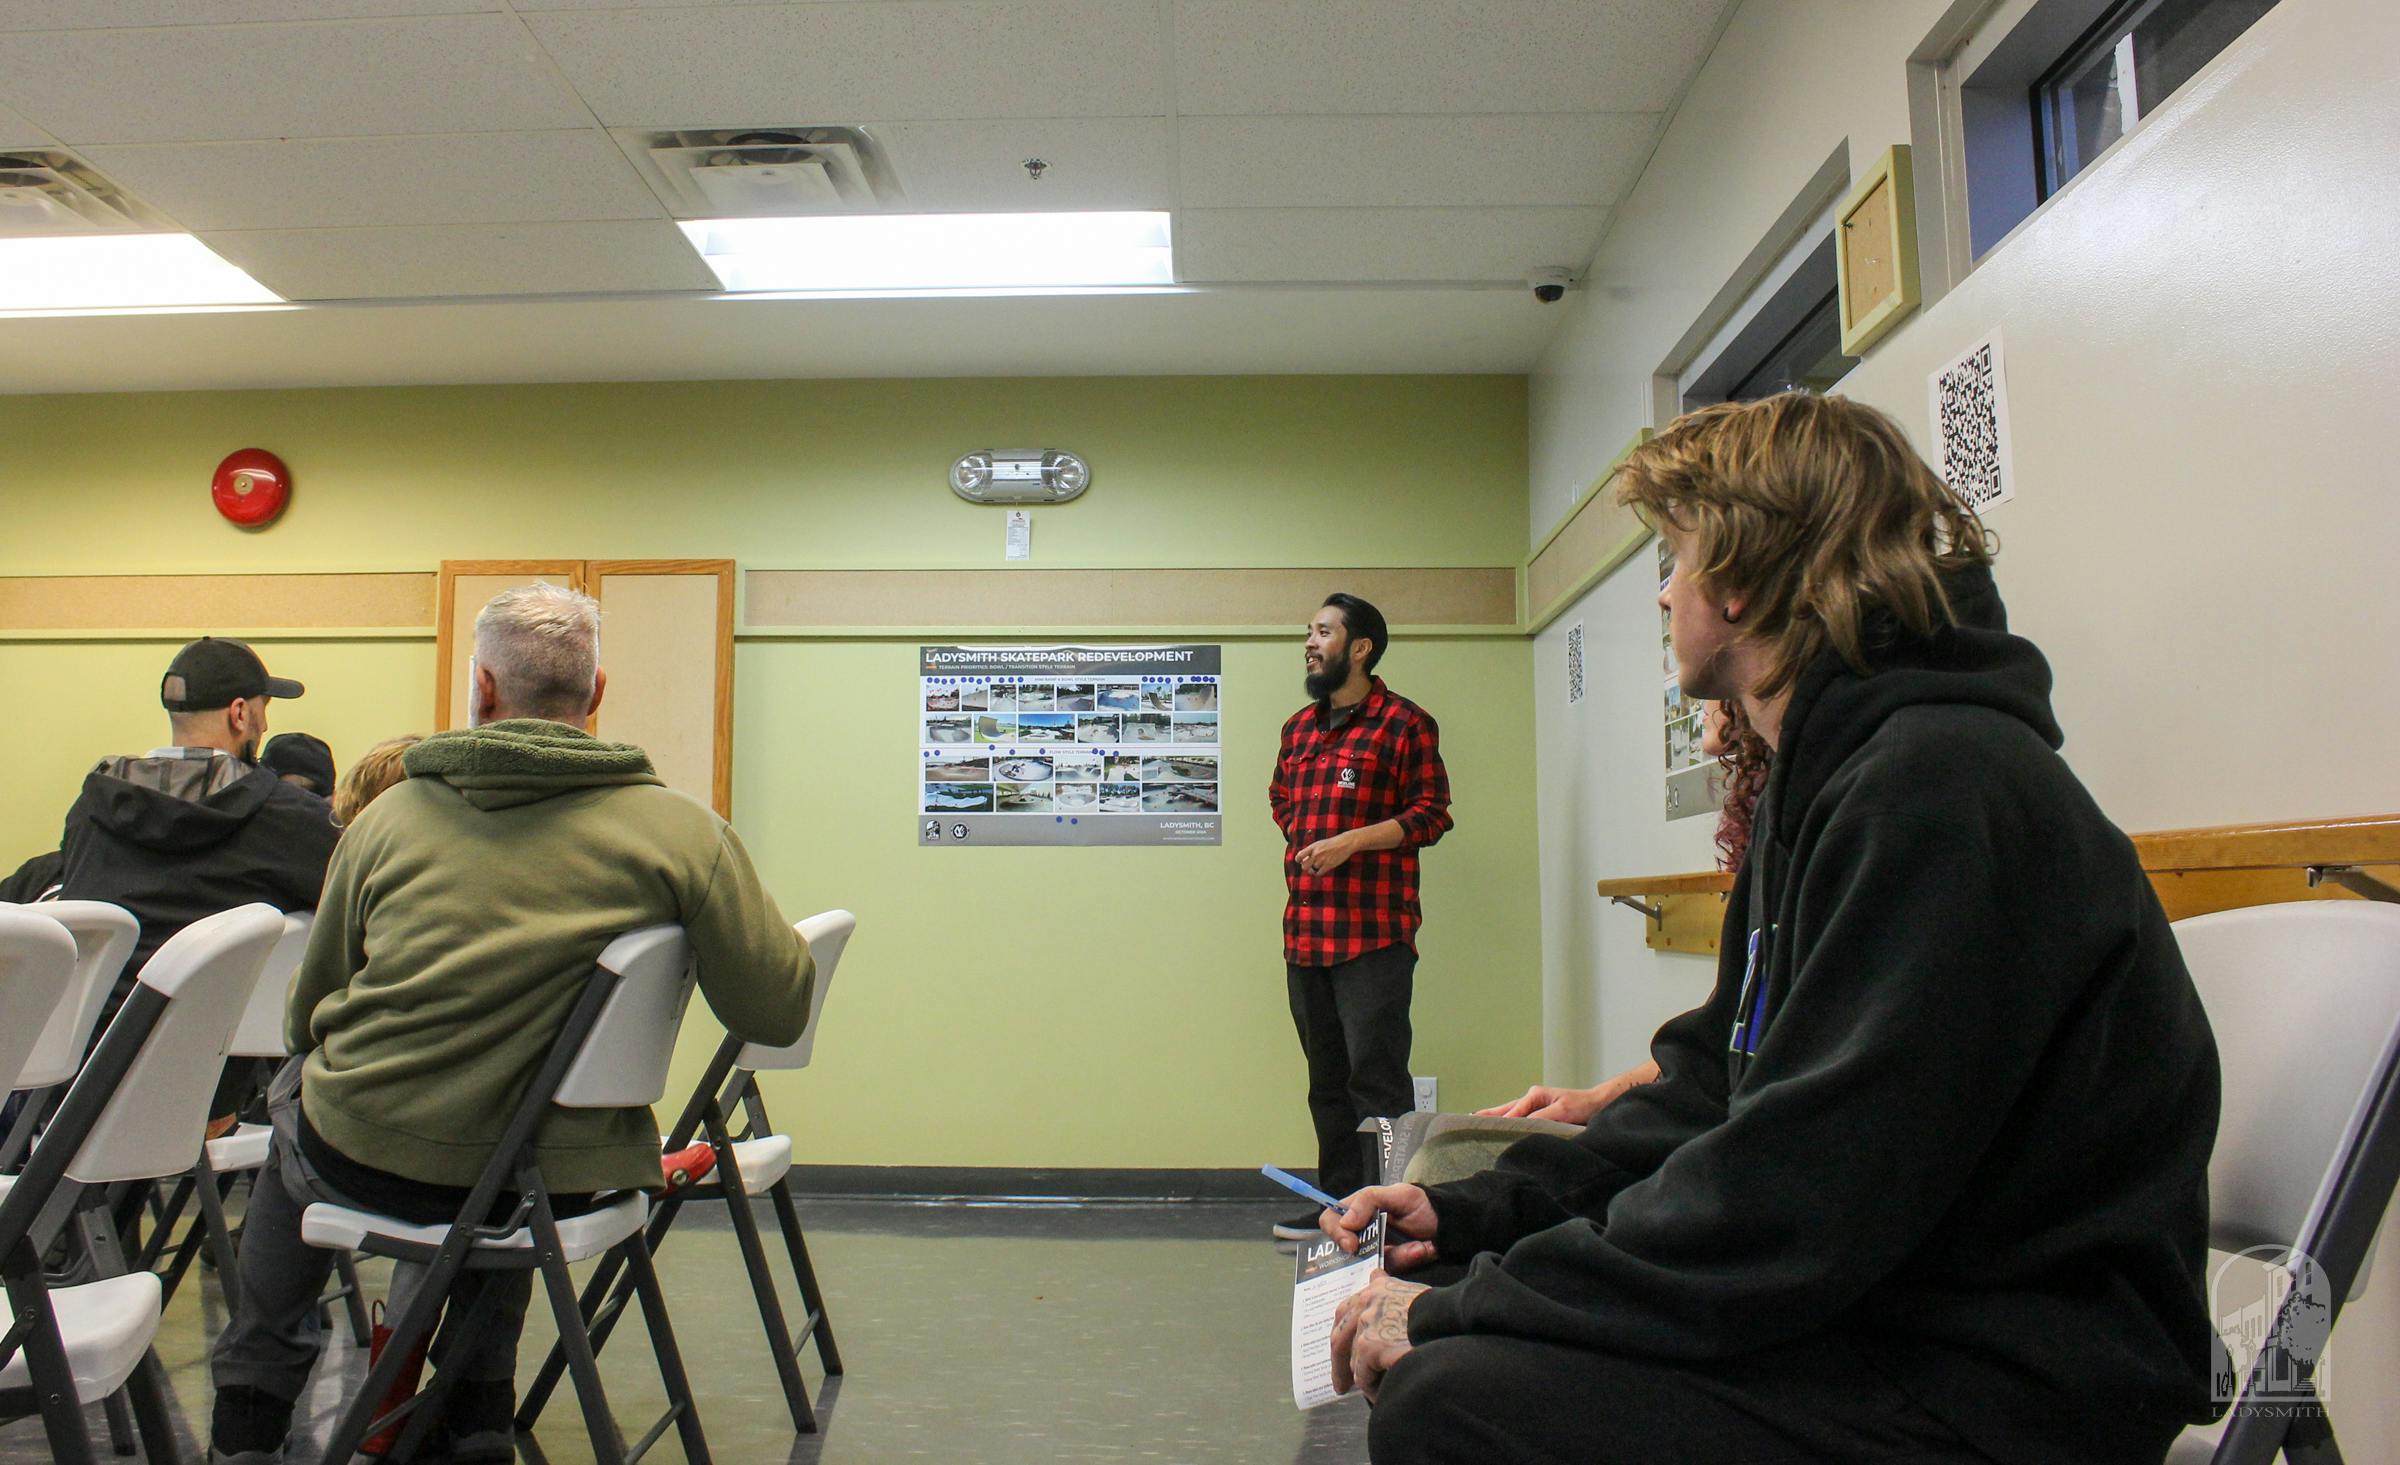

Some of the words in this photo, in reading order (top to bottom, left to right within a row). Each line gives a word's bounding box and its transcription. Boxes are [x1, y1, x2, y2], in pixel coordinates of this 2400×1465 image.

[926, 652, 997, 662] LADYSMITH
[1001, 652, 1074, 662] SKATEPARK
[1078, 651, 1194, 662] REDEVELOPMENT
